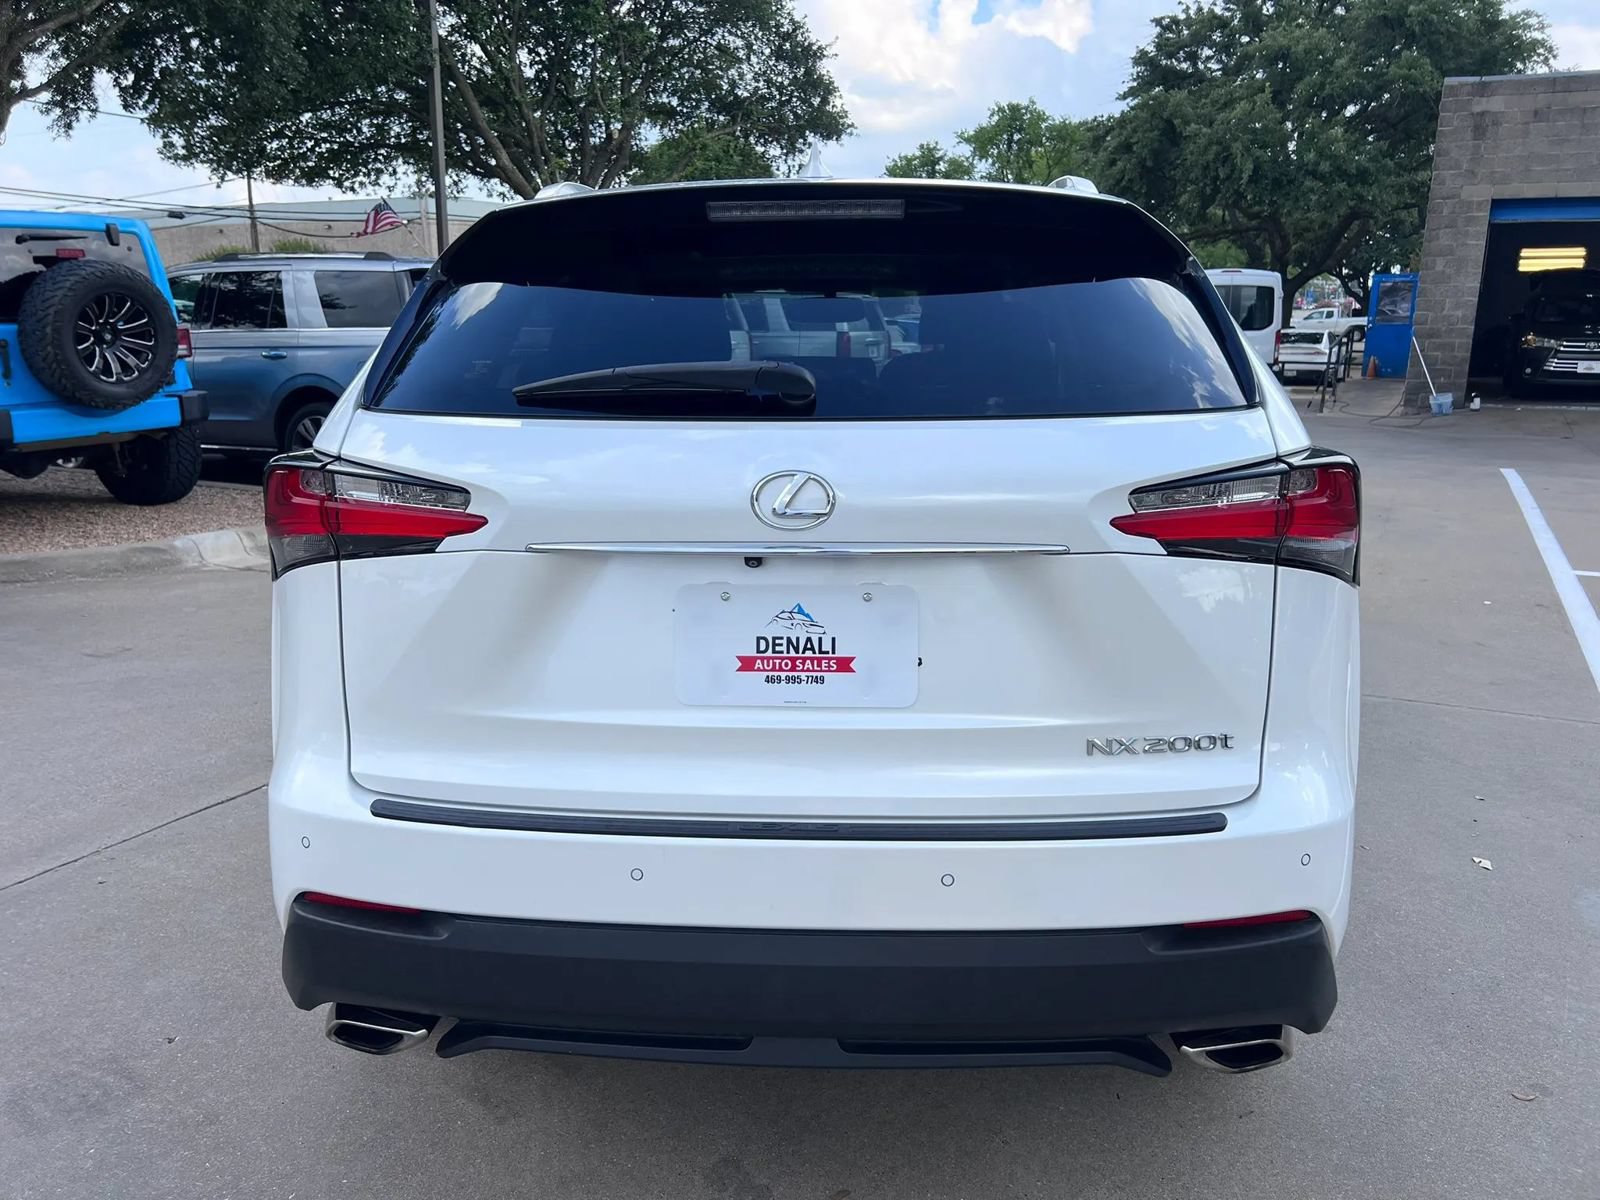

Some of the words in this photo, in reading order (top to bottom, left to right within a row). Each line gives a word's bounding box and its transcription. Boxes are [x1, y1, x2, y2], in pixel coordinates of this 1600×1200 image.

[755, 636, 837, 655] DENALI
[754, 659, 792, 671] AUTO
[795, 659, 838, 671] SALES
[764, 674, 825, 685] 469-995-7749
